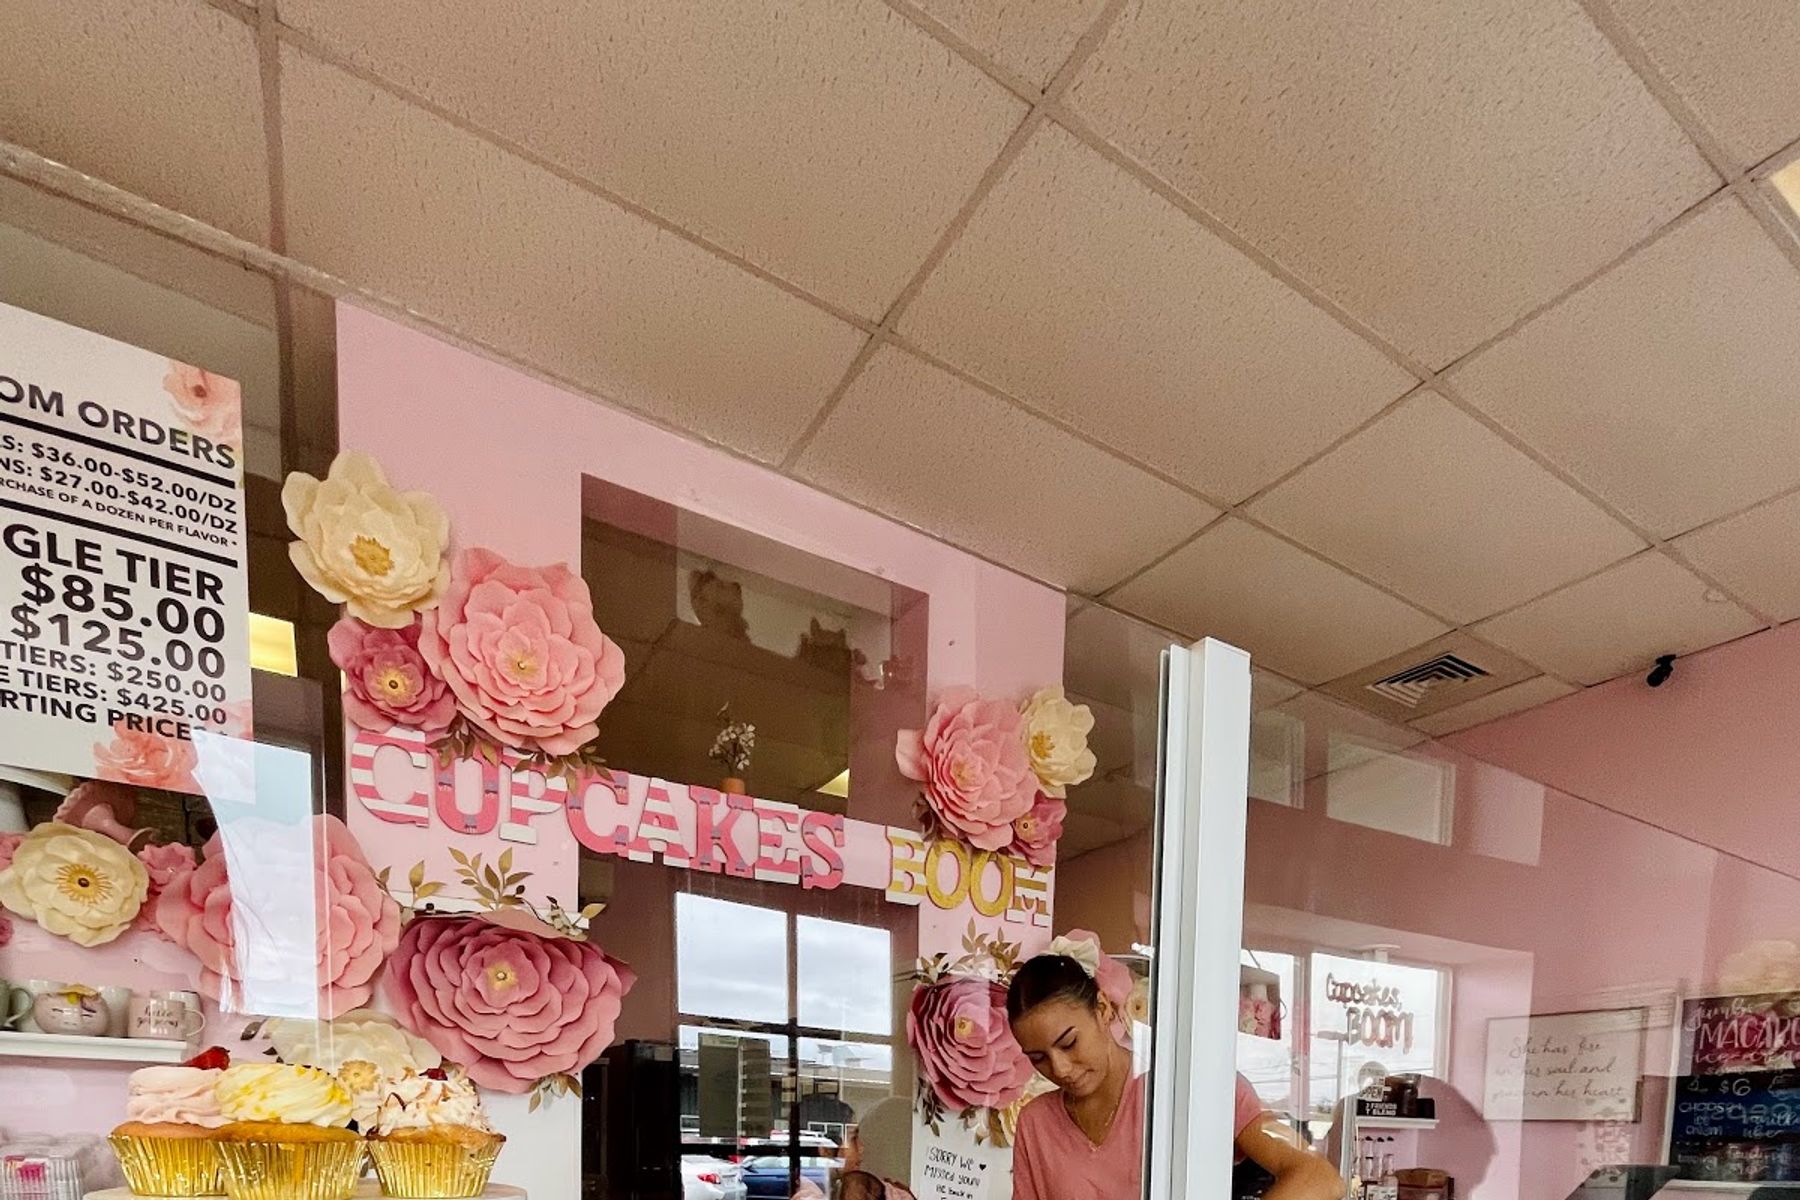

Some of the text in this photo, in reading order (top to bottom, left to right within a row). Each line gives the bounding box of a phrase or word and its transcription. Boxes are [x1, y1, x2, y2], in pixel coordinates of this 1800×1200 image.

[0, 375, 235, 469] OM ORDERS
[31, 442, 237, 514] $36.00-$52.00/DZ
[40, 466, 237, 535] $27.00-$42.00/DZ
[58, 492, 79, 504] OF
[82, 499, 93, 510] A
[96, 502, 145, 523] DOZEN
[149, 516, 174, 531] PER
[177, 524, 228, 546] FLAVOR
[3, 523, 225, 605] GLE TIER
[21, 562, 225, 643] $85.00
[0, 640, 226, 702] TIERS: $250.00
[11, 602, 225, 679] $125.00
[17, 668, 107, 702] TIERS:
[117, 688, 227, 724] $425.00
[107, 708, 207, 741] PRICE
[351, 725, 1054, 928] CUPCAKES BOOM
[1579, 1055, 1617, 1074] and
[928, 1146, 958, 1167] SORRY
